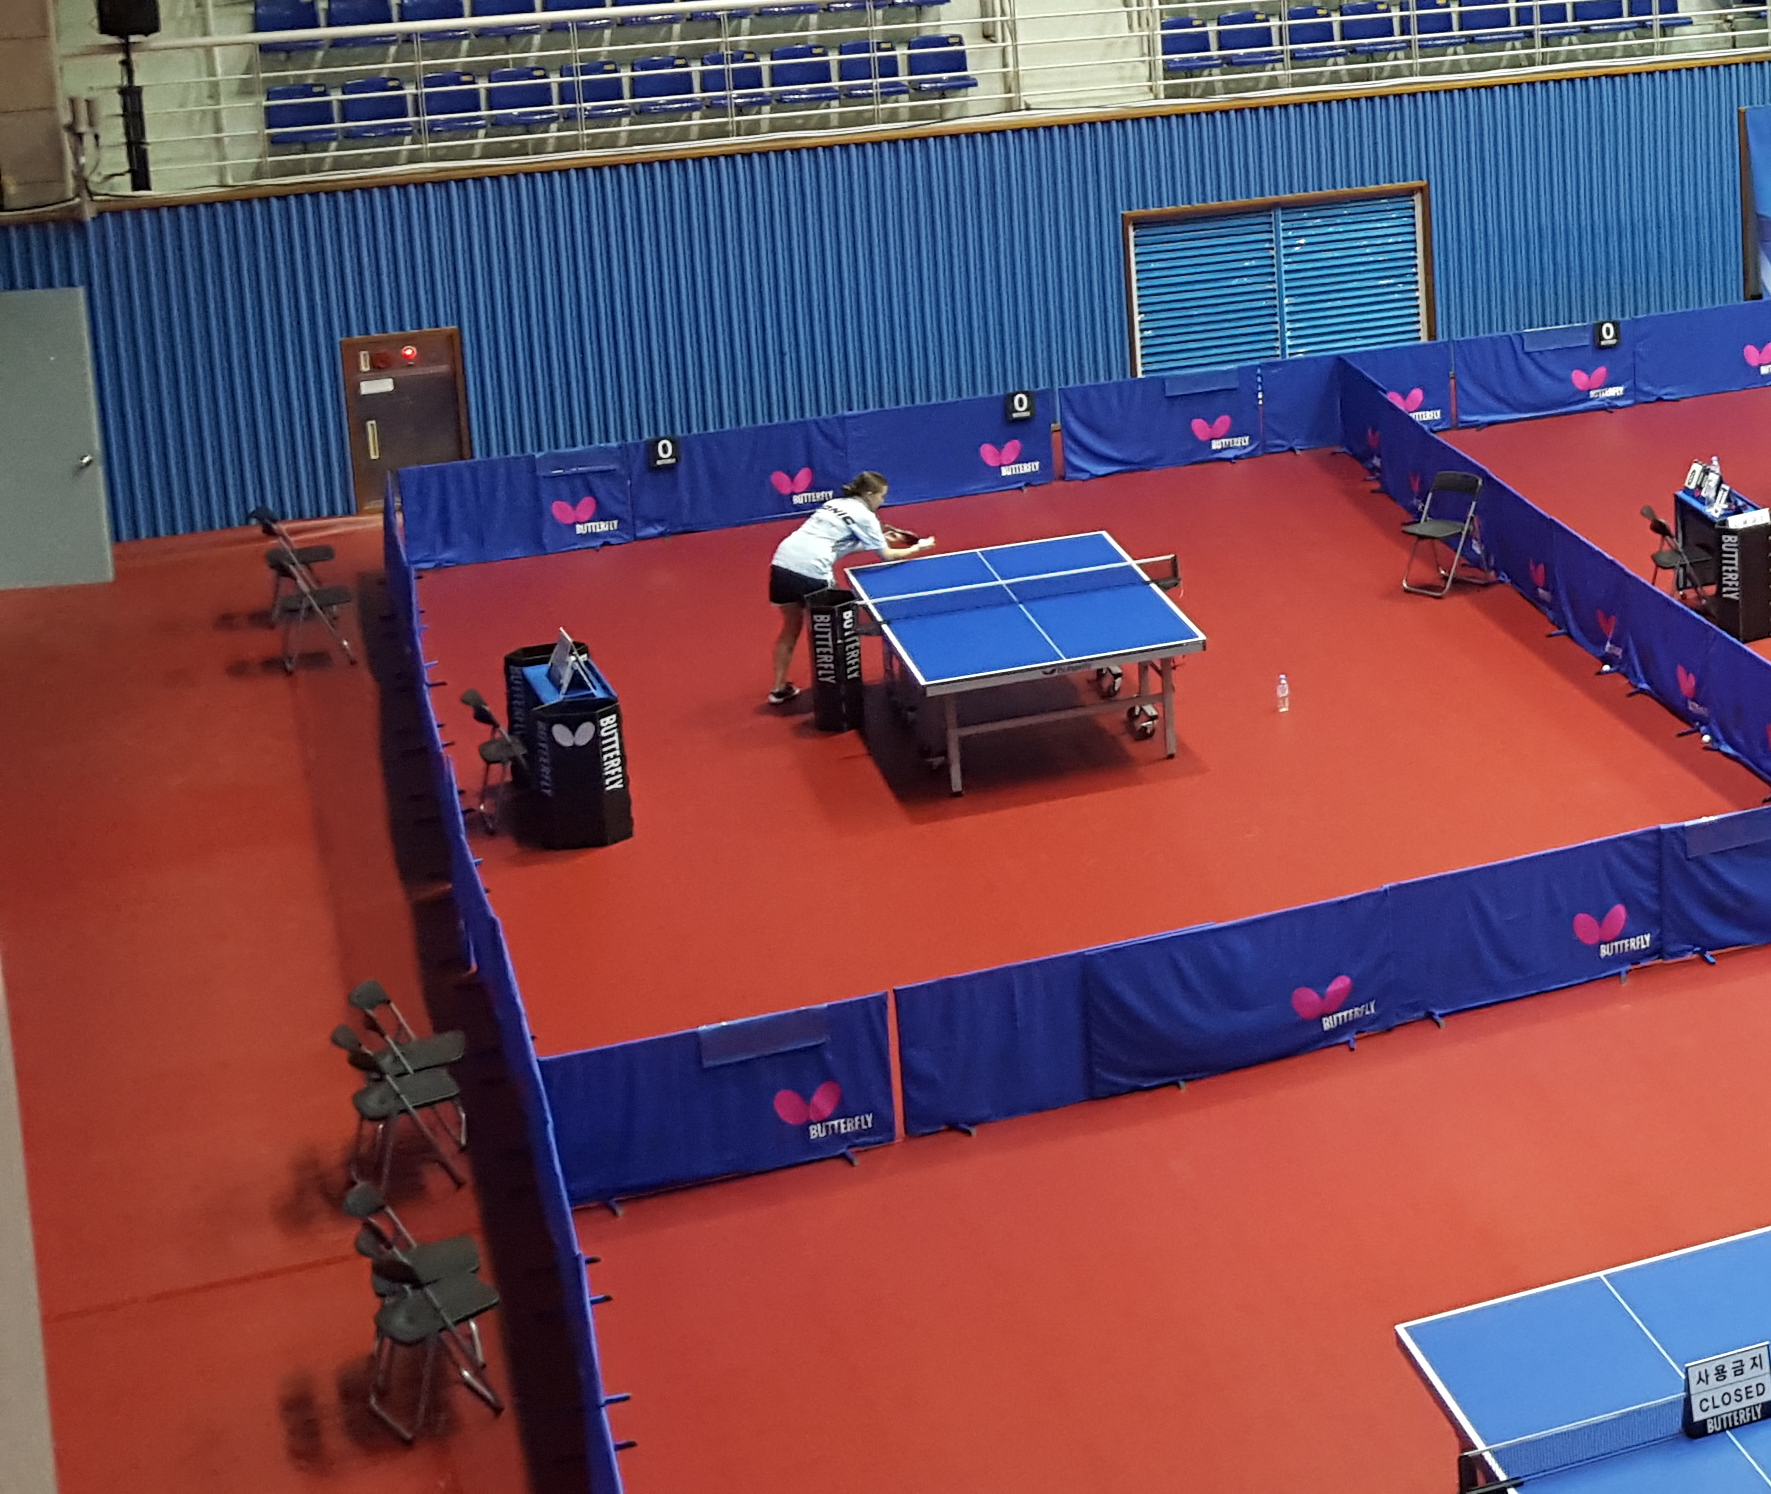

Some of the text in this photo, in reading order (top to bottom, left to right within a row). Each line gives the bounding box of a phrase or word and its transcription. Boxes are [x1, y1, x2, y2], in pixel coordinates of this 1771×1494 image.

[1602, 323, 1614, 339] 0
[1014, 394, 1027, 411] 0
[658, 440, 672, 458] 0
[1211, 436, 1249, 449] BUTTERFLY
[1001, 461, 1040, 476] BUTTERFLY
[792, 490, 834, 505] BUTTERFLY
[576, 520, 618, 534] BUTTERFLY
[1721, 534, 1740, 601] BUTTERFLY
[813, 614, 836, 684] BUTTERFLY
[600, 714, 624, 791] BUTTERFLY
[1600, 933, 1650, 958] BUTTERFLY
[1322, 1001, 1375, 1030] BUTTERFLY
[809, 1113, 873, 1139] BUTTERFLY
[1696, 1353, 1763, 1385] 사용금지
[1699, 1382, 1766, 1412] CLOSED
[1706, 1404, 1762, 1434] BUTTERFLY
